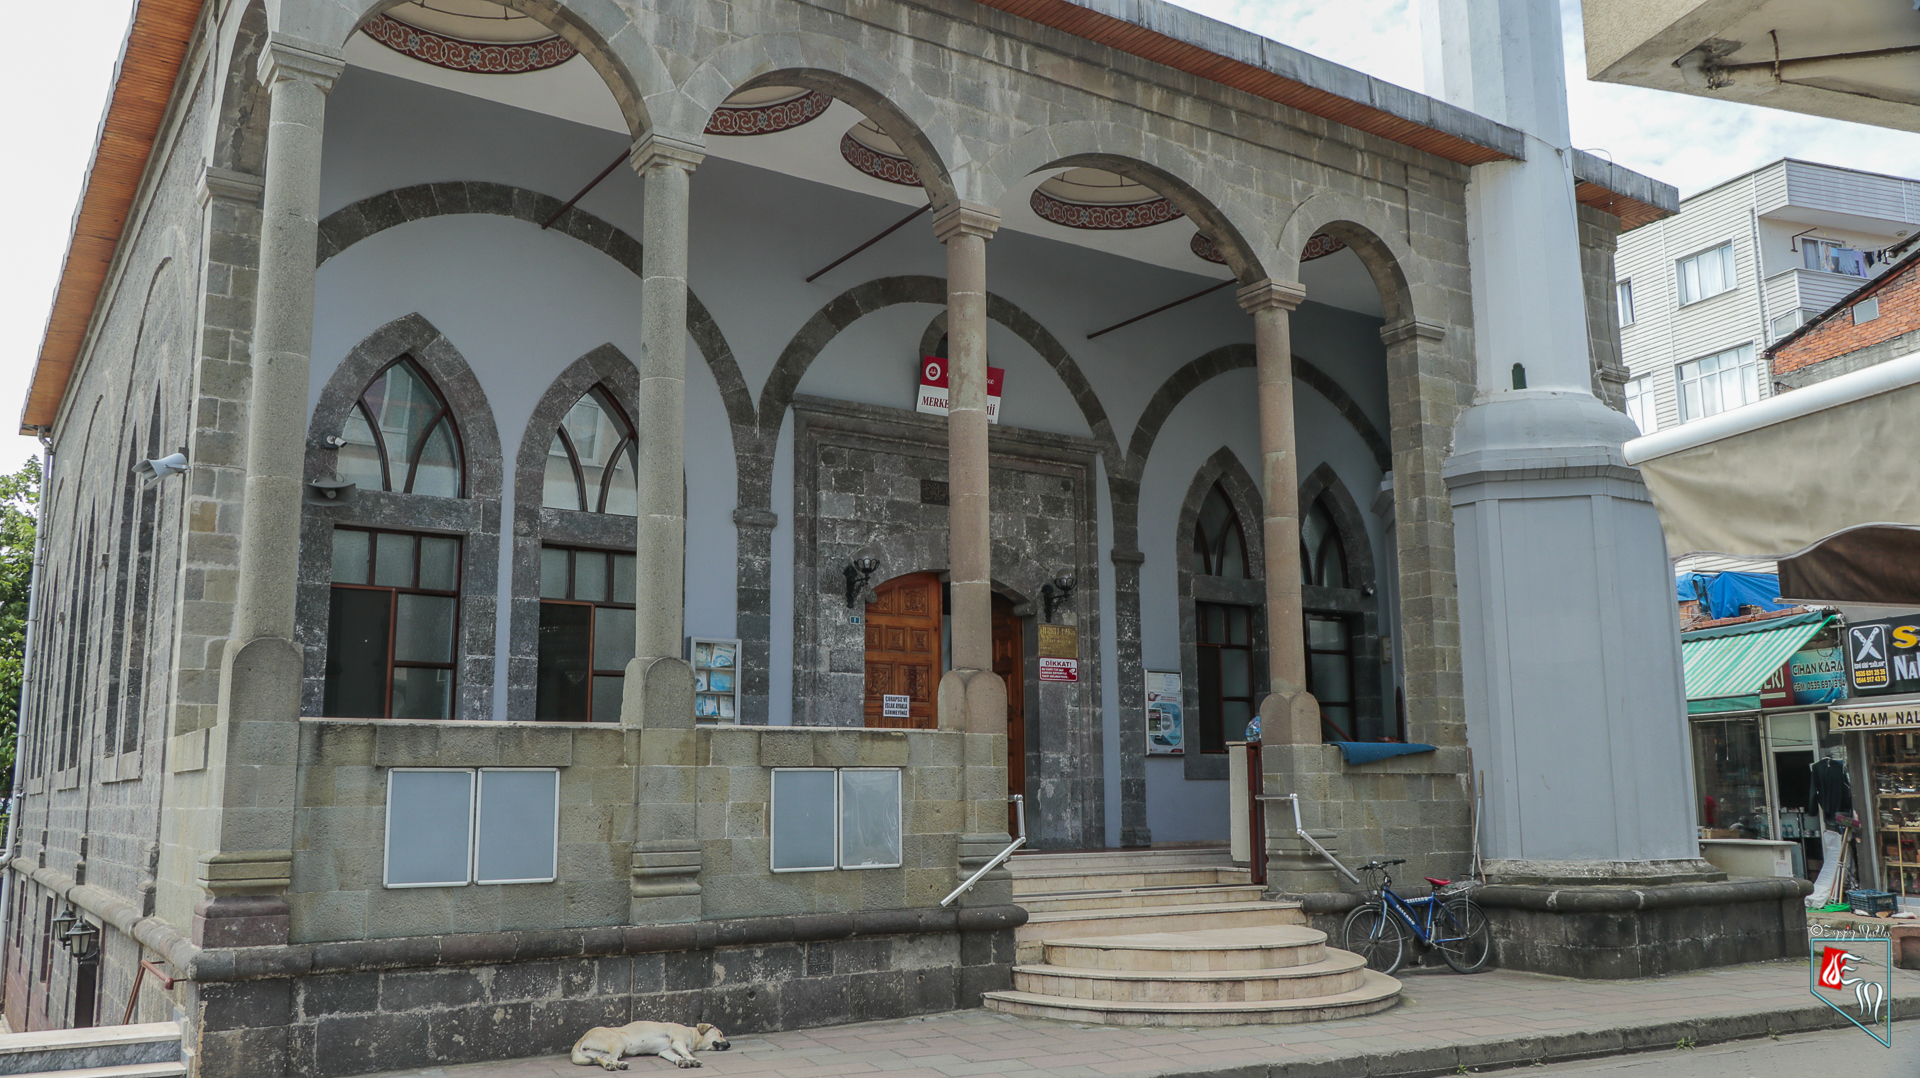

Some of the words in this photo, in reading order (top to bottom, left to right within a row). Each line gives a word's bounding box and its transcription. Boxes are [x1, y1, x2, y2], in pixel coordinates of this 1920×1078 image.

[921, 396, 948, 409] MERKE
[1892, 625, 1920, 648] S
[1792, 661, 1817, 676] CİHAN
[1818, 659, 1844, 674] KARA
[1837, 711, 1888, 727] SAĞLAM
[1895, 710, 1920, 725] NAL
